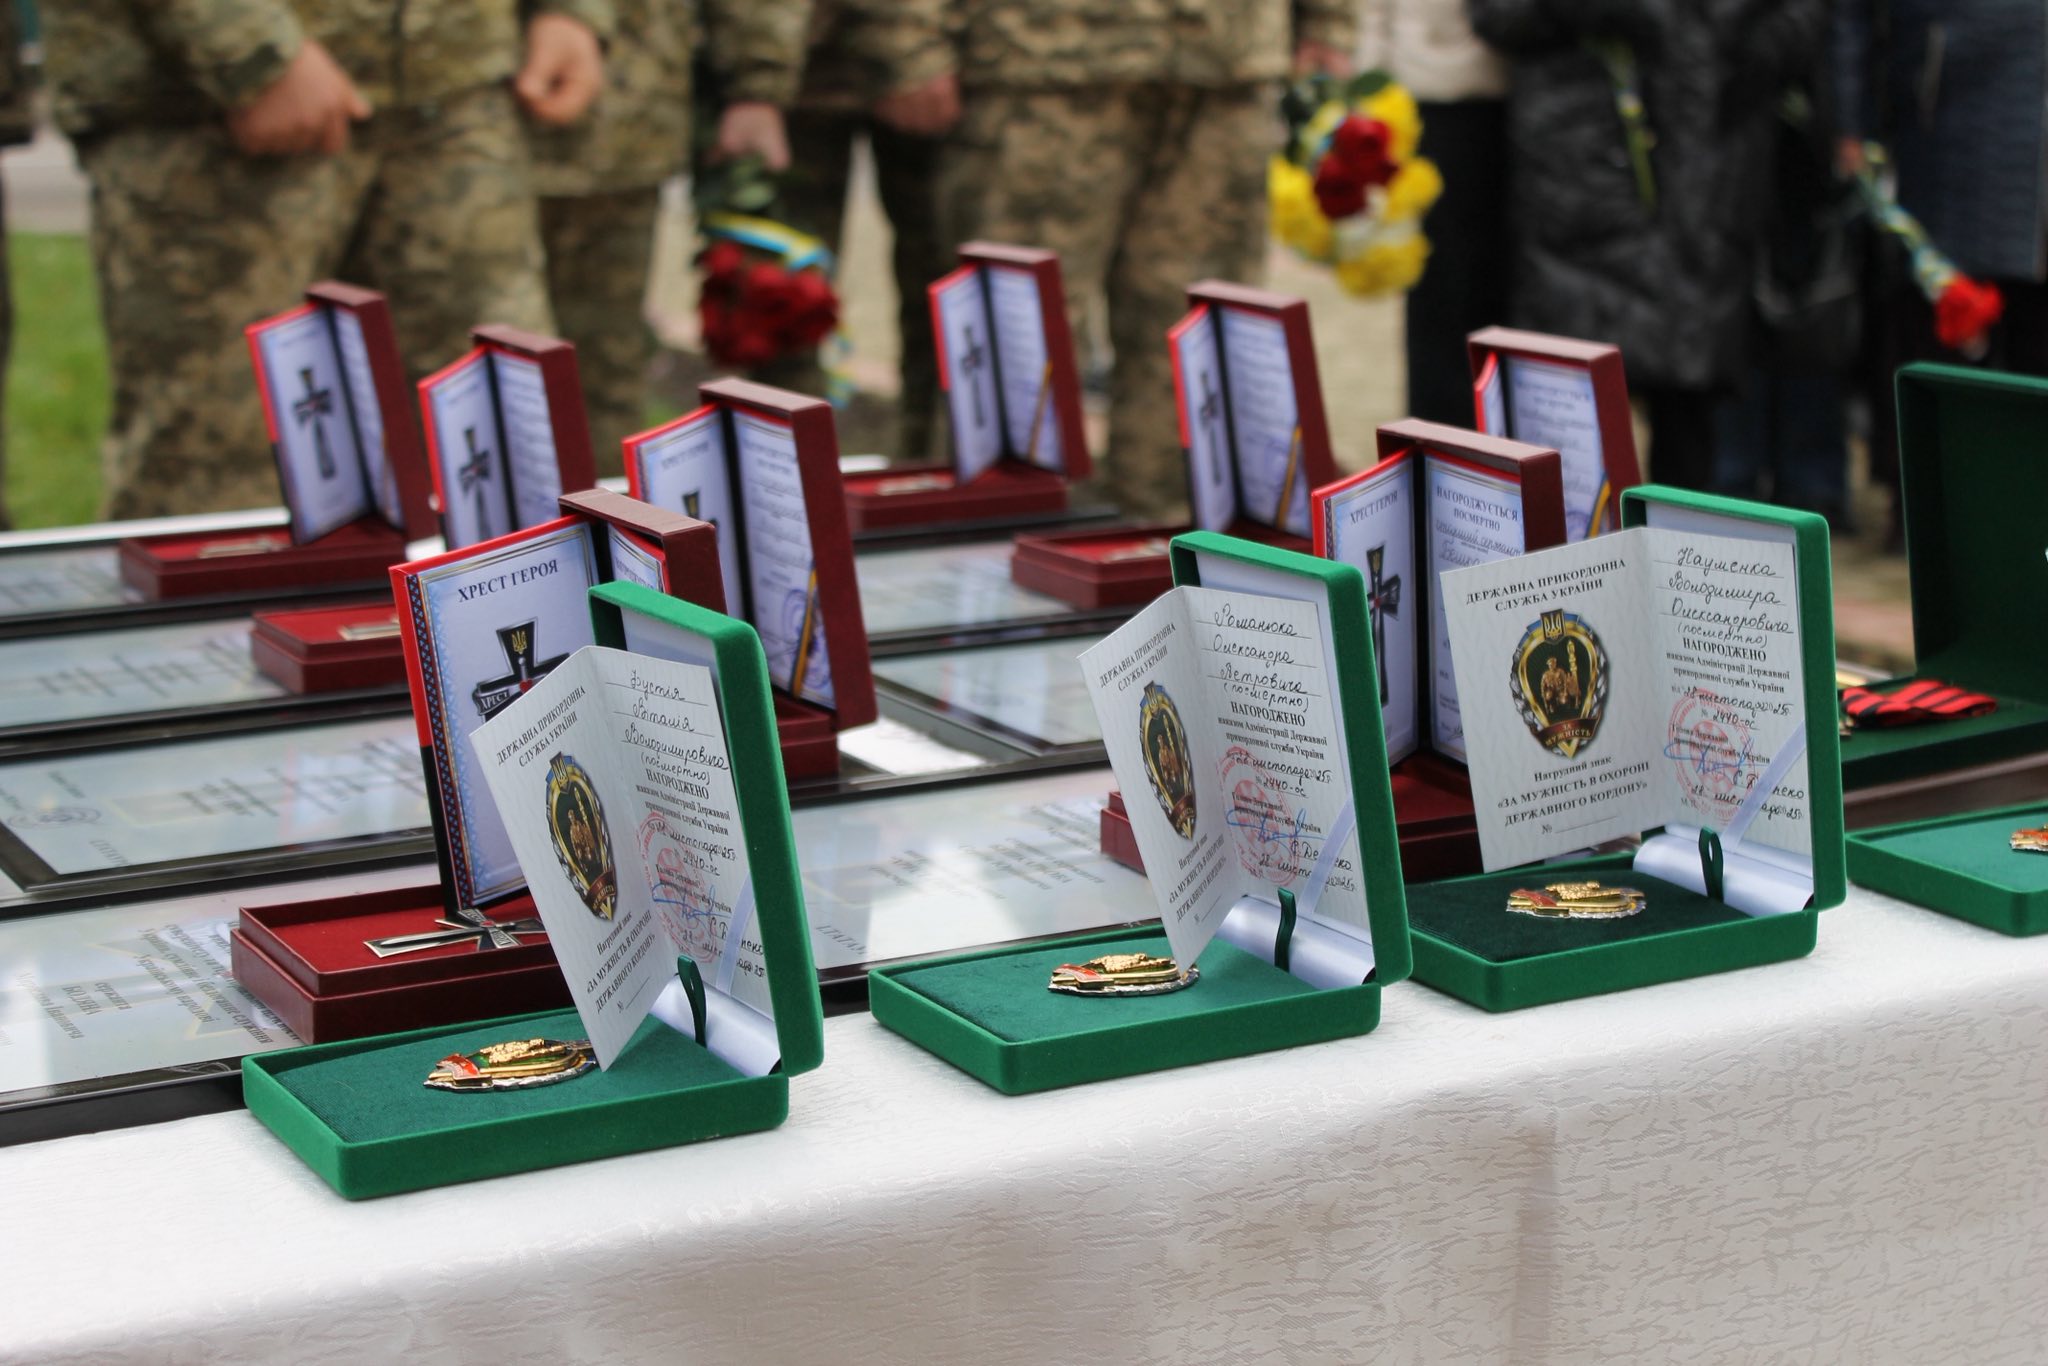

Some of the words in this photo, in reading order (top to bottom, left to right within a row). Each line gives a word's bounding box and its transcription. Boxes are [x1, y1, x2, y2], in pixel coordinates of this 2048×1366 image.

[1350, 504, 1379, 525] ХРЕСТ
[1377, 490, 1399, 515] ГЕРОЯ
[1436, 485, 1519, 522] НАГОРОДЖУЄТЬСЯ
[1453, 508, 1500, 531] ПОСМЕРТНО
[1678, 547, 1777, 577] Науменка
[457, 575, 508, 602] ХРЕСТ
[510, 559, 559, 586] ГЕРОЯ
[1466, 582, 1535, 605] ДЕРЖАВНА
[1538, 558, 1626, 588] ПРИКОРДОННА
[1495, 592, 1549, 612] СЛУЖБА
[1552, 578, 1603, 600] УКРАЇНИ
[1668, 570, 1781, 610] Володимира
[1214, 603, 1298, 637] Романюка
[1671, 596, 1794, 635] Олександровича
[1213, 633, 1296, 669] Олександра
[1677, 621, 1768, 649] (посмертно)
[1683, 638, 1767, 663] НАГОРОДЖЕНО
[1100, 654, 1136, 688] ДЕРЖАВНА
[1134, 622, 1177, 661] ПРИКОРДОННА
[1118, 666, 1145, 692] СЛУЖБА
[1143, 645, 1168, 671] УКРАЇНИ
[1666, 652, 1695, 664] наказом
[1697, 655, 1746, 675] Адміністрації
[1747, 665, 1790, 681] Державної
[1223, 682, 1310, 713] (посмертно)
[1673, 667, 1721, 684] прикордонної
[1722, 675, 1750, 690] служби
[1752, 679, 1785, 694] України
[481, 689, 511, 711] ХРЕСТ
[632, 696, 696, 733] Віталія
[1230, 701, 1306, 727] НАГОРОДЖЕНО
[496, 727, 539, 766] ДЕРЖАВНА
[537, 685, 586, 732] ПРИКОРДОННА
[518, 738, 550, 768] СЛУЖБА
[549, 711, 578, 742] УКРАЇНИ
[1217, 716, 1244, 730] наказом
[1245, 720, 1289, 739] Адміністрації
[1290, 731, 1328, 747] Державної
[1545, 729, 1591, 746] МУЖНІСТЬ
[1225, 731, 1269, 750] прикордонної
[1270, 740, 1296, 756] служби
[1295, 744, 1325, 761] України
[640, 752, 712, 786] (посмертно)
[645, 768, 710, 800] НАГОРОДЖЕНО
[1497, 795, 1518, 809] «ЗА
[1521, 782, 1587, 804] МУЖНІСТЬ
[1590, 775, 1597, 786] В
[1599, 761, 1650, 783] ОХОРОНІ
[1534, 761, 1588, 782] Нагрудний
[1590, 756, 1612, 769] знак
[660, 789, 697, 812] Адміністрації
[696, 802, 731, 821] Державної
[1504, 796, 1588, 827] ДЕРЖАВНОГО
[1590, 780, 1648, 804] КОРДОНУ»
[701, 818, 729, 836] України
[597, 921, 622, 956] Нагрудний
[597, 944, 630, 981] МУЖНІСТЬ
[629, 909, 653, 944] ОХОРОНІ
[61, 985, 103, 1016] БОДЯНА
[94, 981, 133, 1010] сержанта
[133, 953, 186, 996] Українському
[176, 994, 222, 1024] народові
[595, 961, 635, 1013] ДЕРЖАВНОГО
[43, 1004, 86, 1040] Івановича
[232, 1010, 274, 1045] служіння
